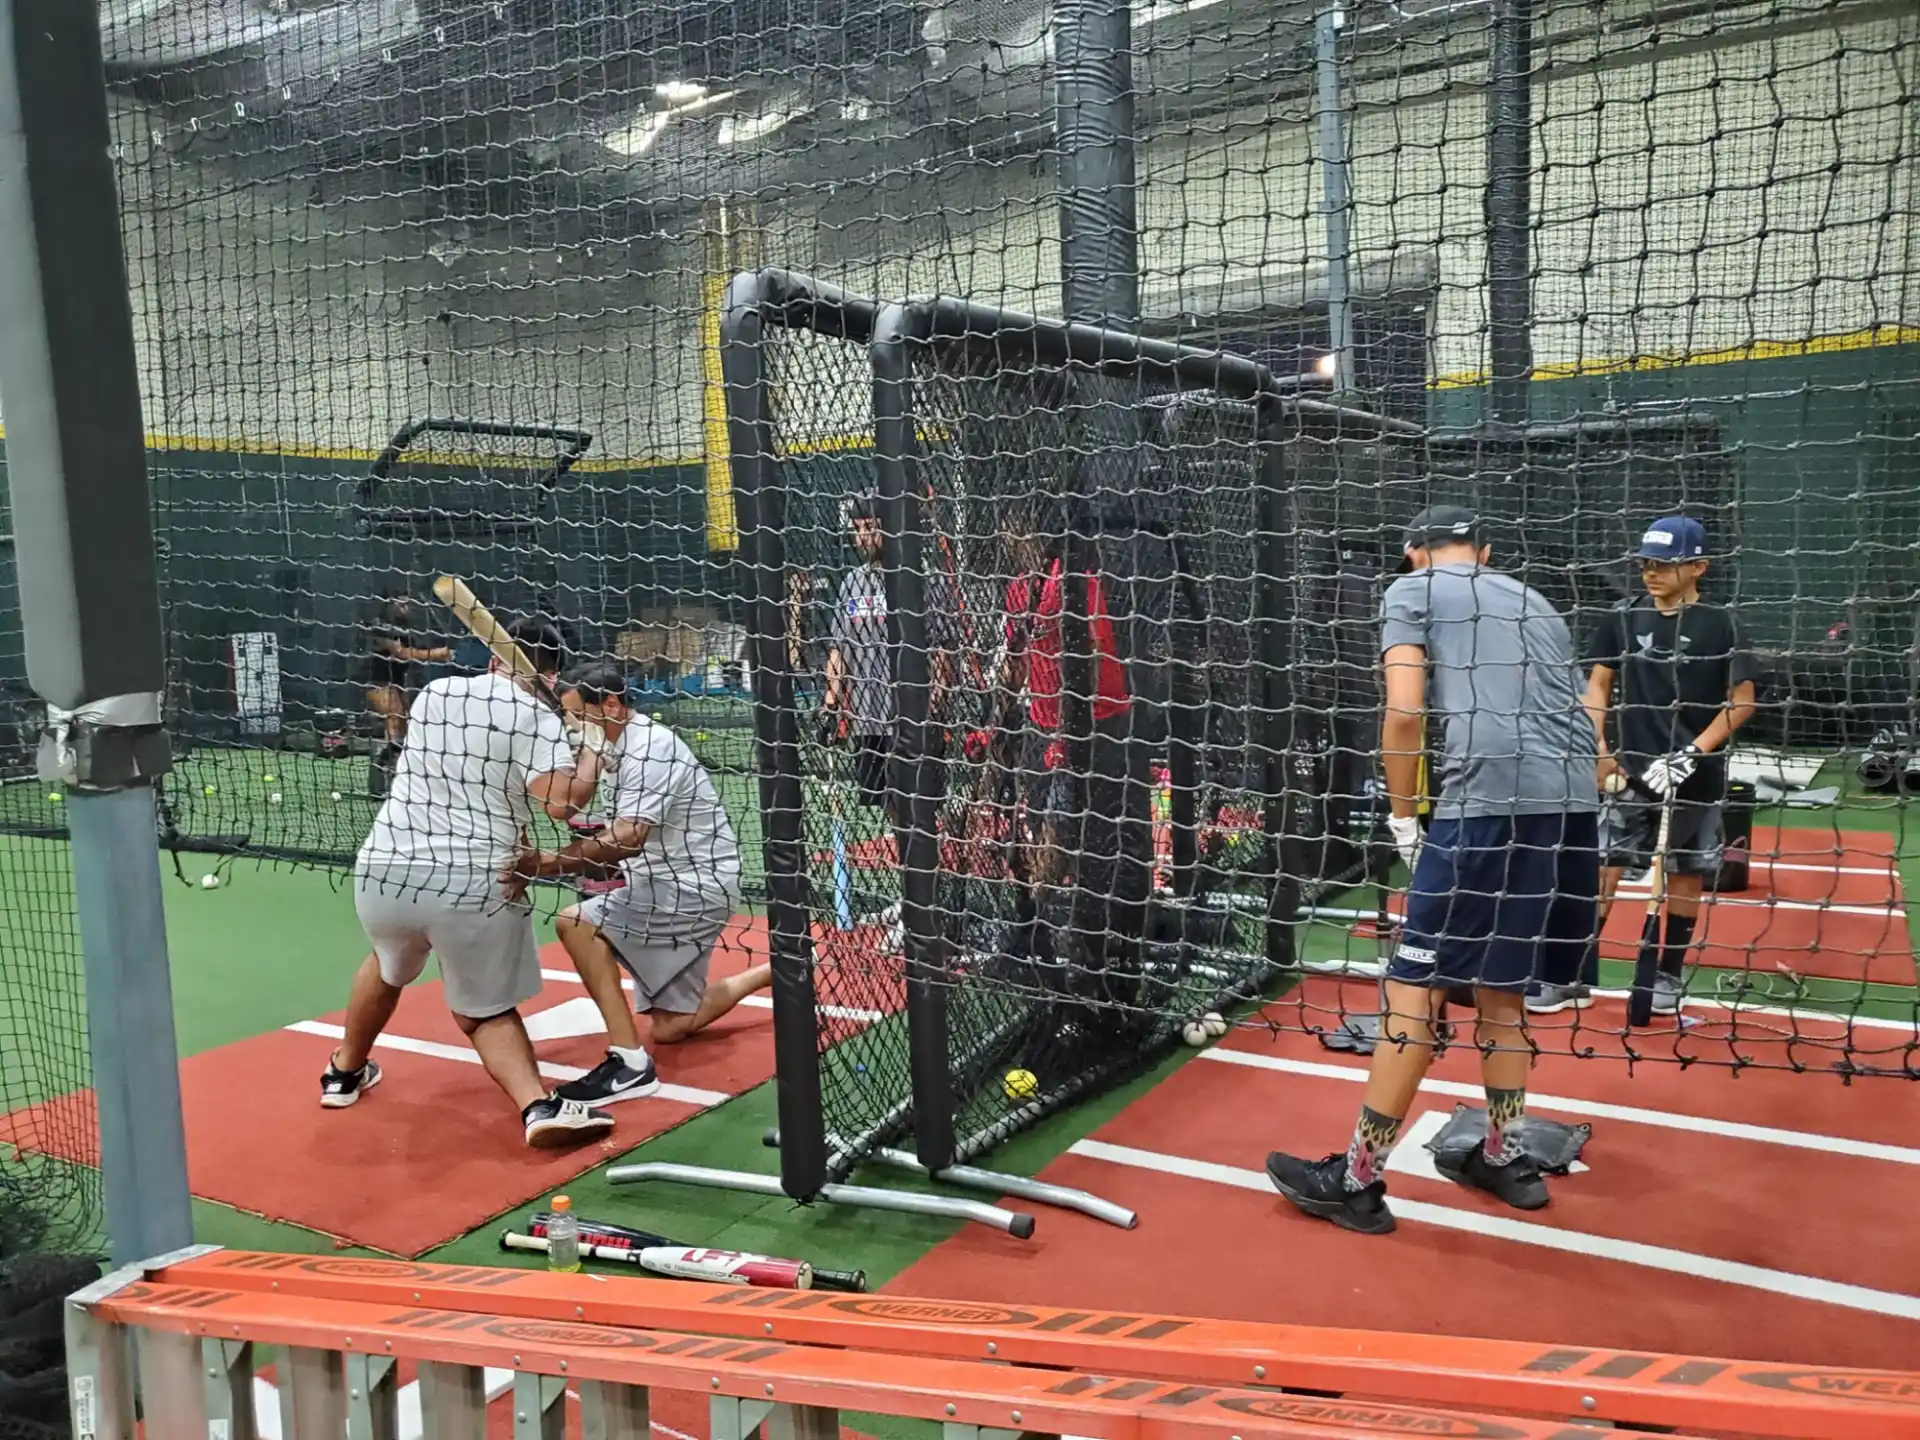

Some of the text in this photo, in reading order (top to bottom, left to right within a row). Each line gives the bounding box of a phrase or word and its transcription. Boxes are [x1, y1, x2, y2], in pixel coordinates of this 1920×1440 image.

[869, 1303, 1000, 1321] WERNER
[511, 1325, 622, 1344] WERNER
[1265, 1402, 1454, 1434] WERNER
